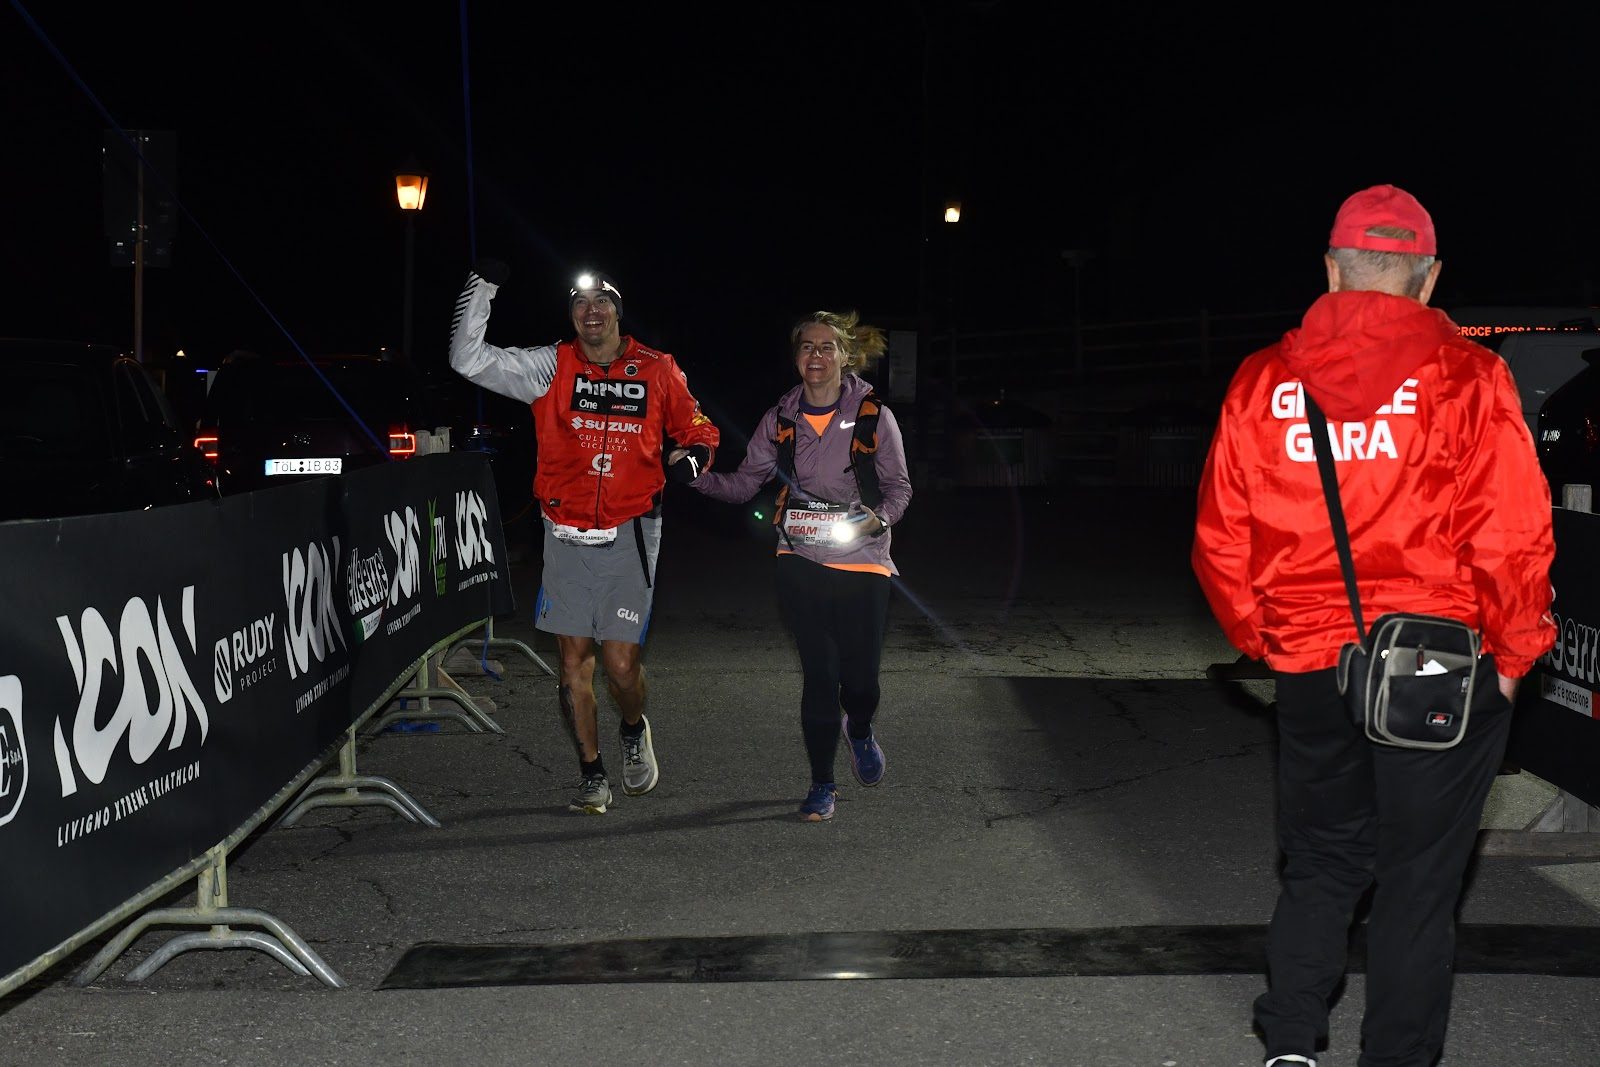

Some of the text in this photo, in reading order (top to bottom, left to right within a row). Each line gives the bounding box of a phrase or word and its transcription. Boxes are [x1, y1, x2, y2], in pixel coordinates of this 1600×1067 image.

[576, 377, 645, 399] HINO
[579, 399, 598, 410] One
[584, 419, 643, 434] SUZUKI
[578, 434, 627, 444] CULTURA
[324, 459, 339, 472] 83
[790, 511, 843, 522] SUPPORT
[787, 525, 818, 536] TEAM
[616, 607, 639, 624] GUA
[232, 612, 275, 672] RUDY
[240, 657, 277, 691] PROJECT
[57, 760, 200, 848] LIVIGNO XTREME TRIATHLON
